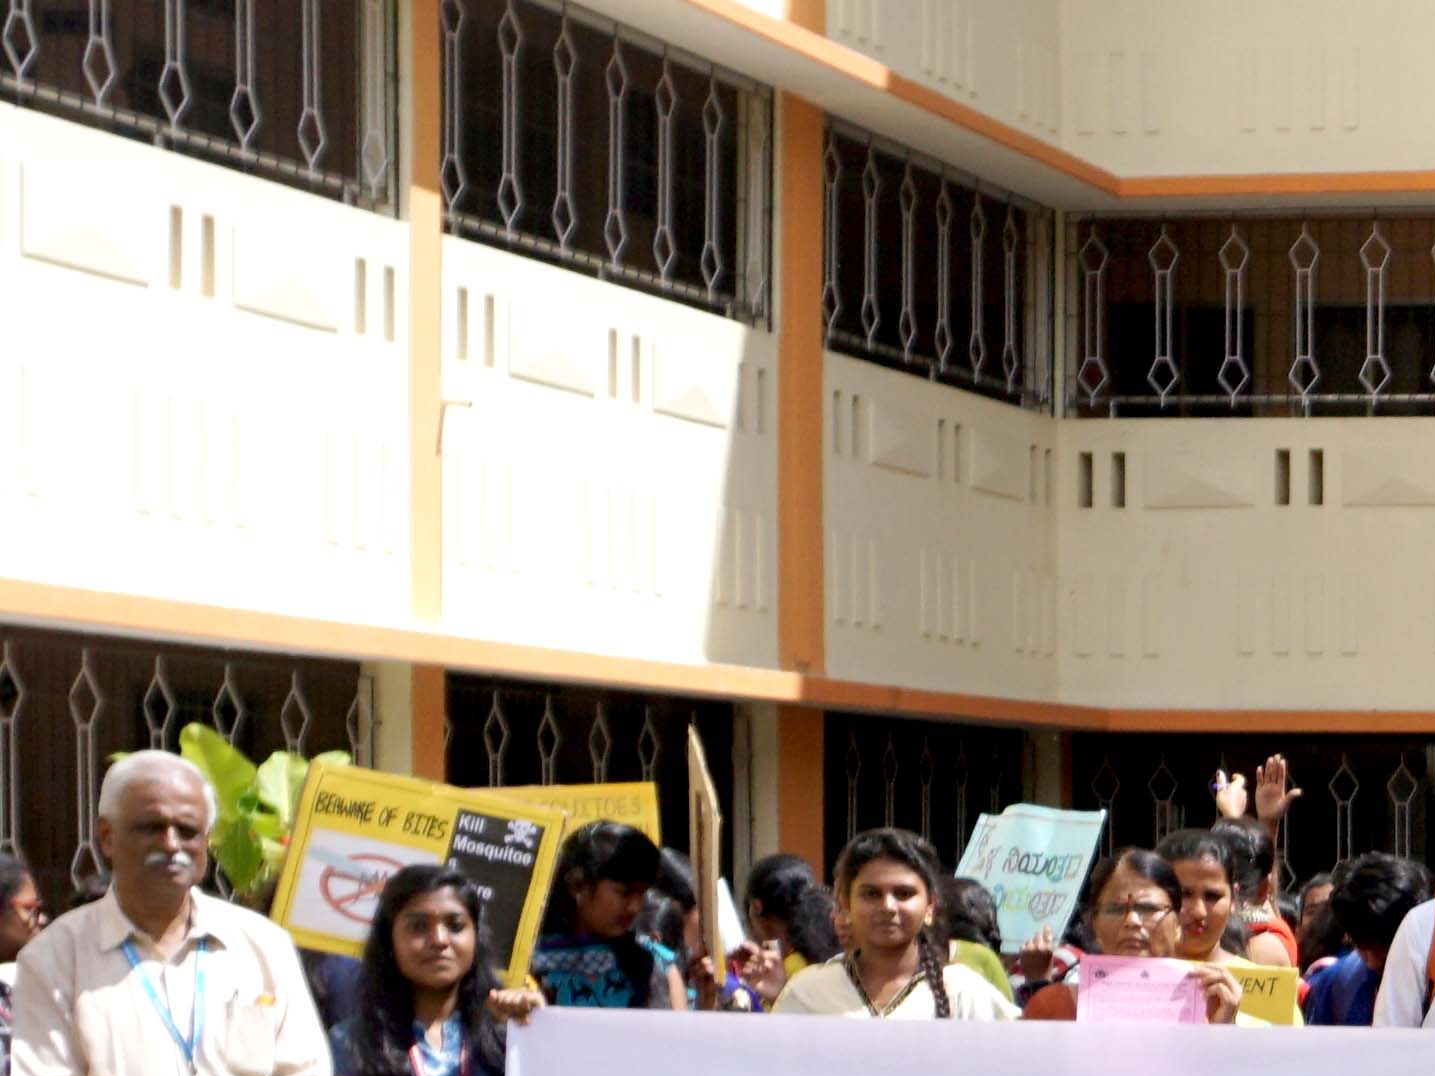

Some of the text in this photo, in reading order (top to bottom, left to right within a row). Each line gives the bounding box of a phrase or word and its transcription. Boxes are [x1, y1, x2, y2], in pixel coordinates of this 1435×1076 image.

[379, 807, 399, 827] OF
[402, 810, 448, 840] BITES
[458, 813, 486, 834] Kill
[452, 834, 532, 866] Mosquitoe
